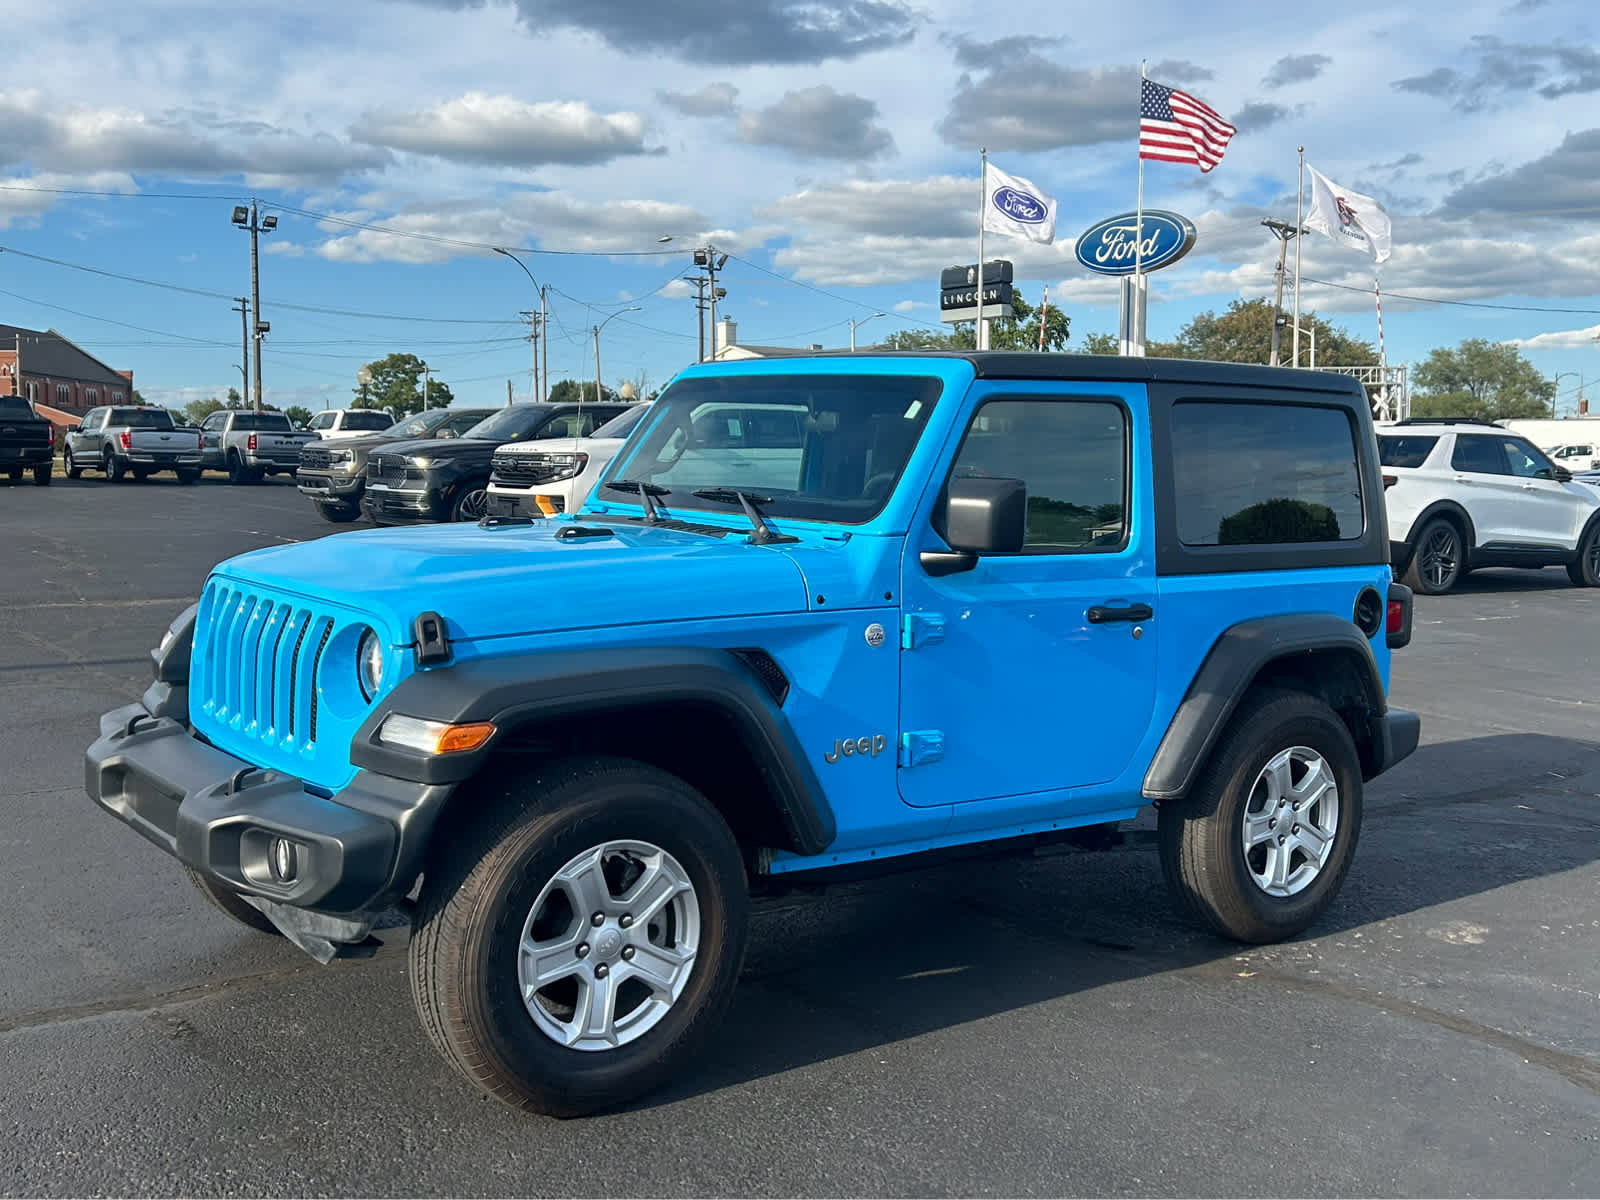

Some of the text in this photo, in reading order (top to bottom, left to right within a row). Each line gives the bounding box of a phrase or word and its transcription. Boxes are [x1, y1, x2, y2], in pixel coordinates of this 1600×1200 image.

[1005, 191, 1038, 218] Ford
[1096, 224, 1160, 262] Ford
[943, 289, 997, 305] LINCOLN
[824, 735, 886, 764] Jeep
